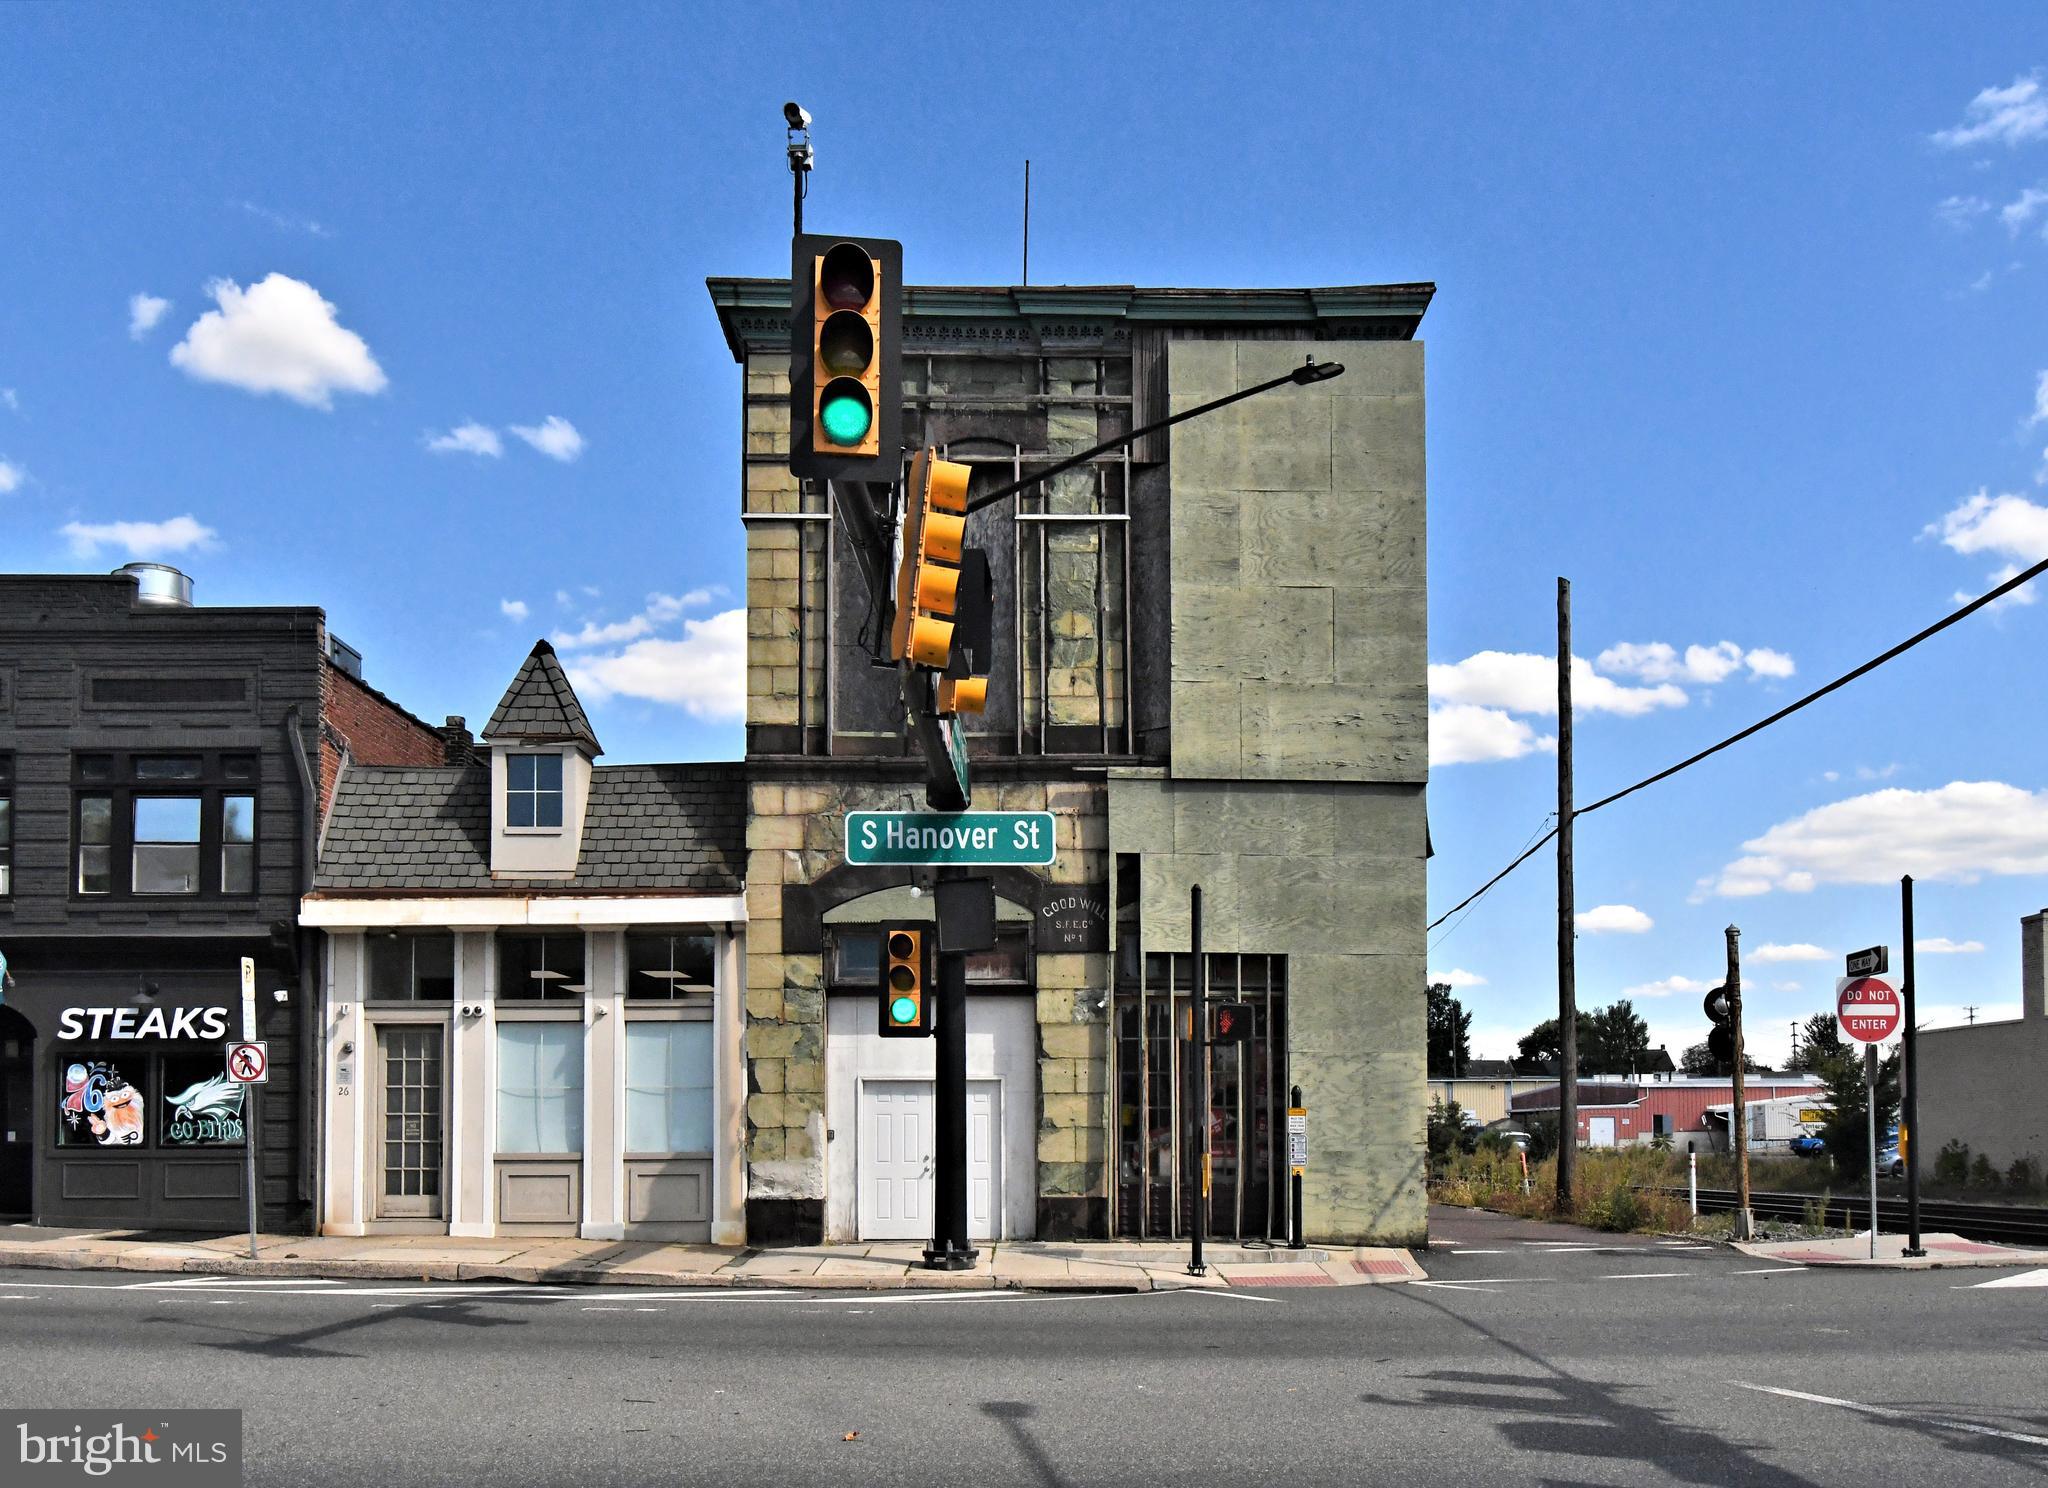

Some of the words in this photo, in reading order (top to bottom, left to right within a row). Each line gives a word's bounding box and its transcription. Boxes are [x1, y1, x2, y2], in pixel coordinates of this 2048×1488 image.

[861, 820, 878, 849] S
[886, 820, 998, 849] Hanover
[1012, 820, 1040, 849] St
[1042, 897, 1076, 917] GOOD
[1079, 897, 1106, 920] WILL
[1861, 956, 1871, 968] WAY
[1847, 990, 1862, 1001] DO
[1869, 990, 1890, 1001] NOT
[57, 1007, 228, 1040] STEAKS
[1851, 1019, 1887, 1030] ENTER
[338, 1086, 350, 1096] 26
[170, 1121, 193, 1139] GO
[197, 1119, 243, 1140] BIRDS
